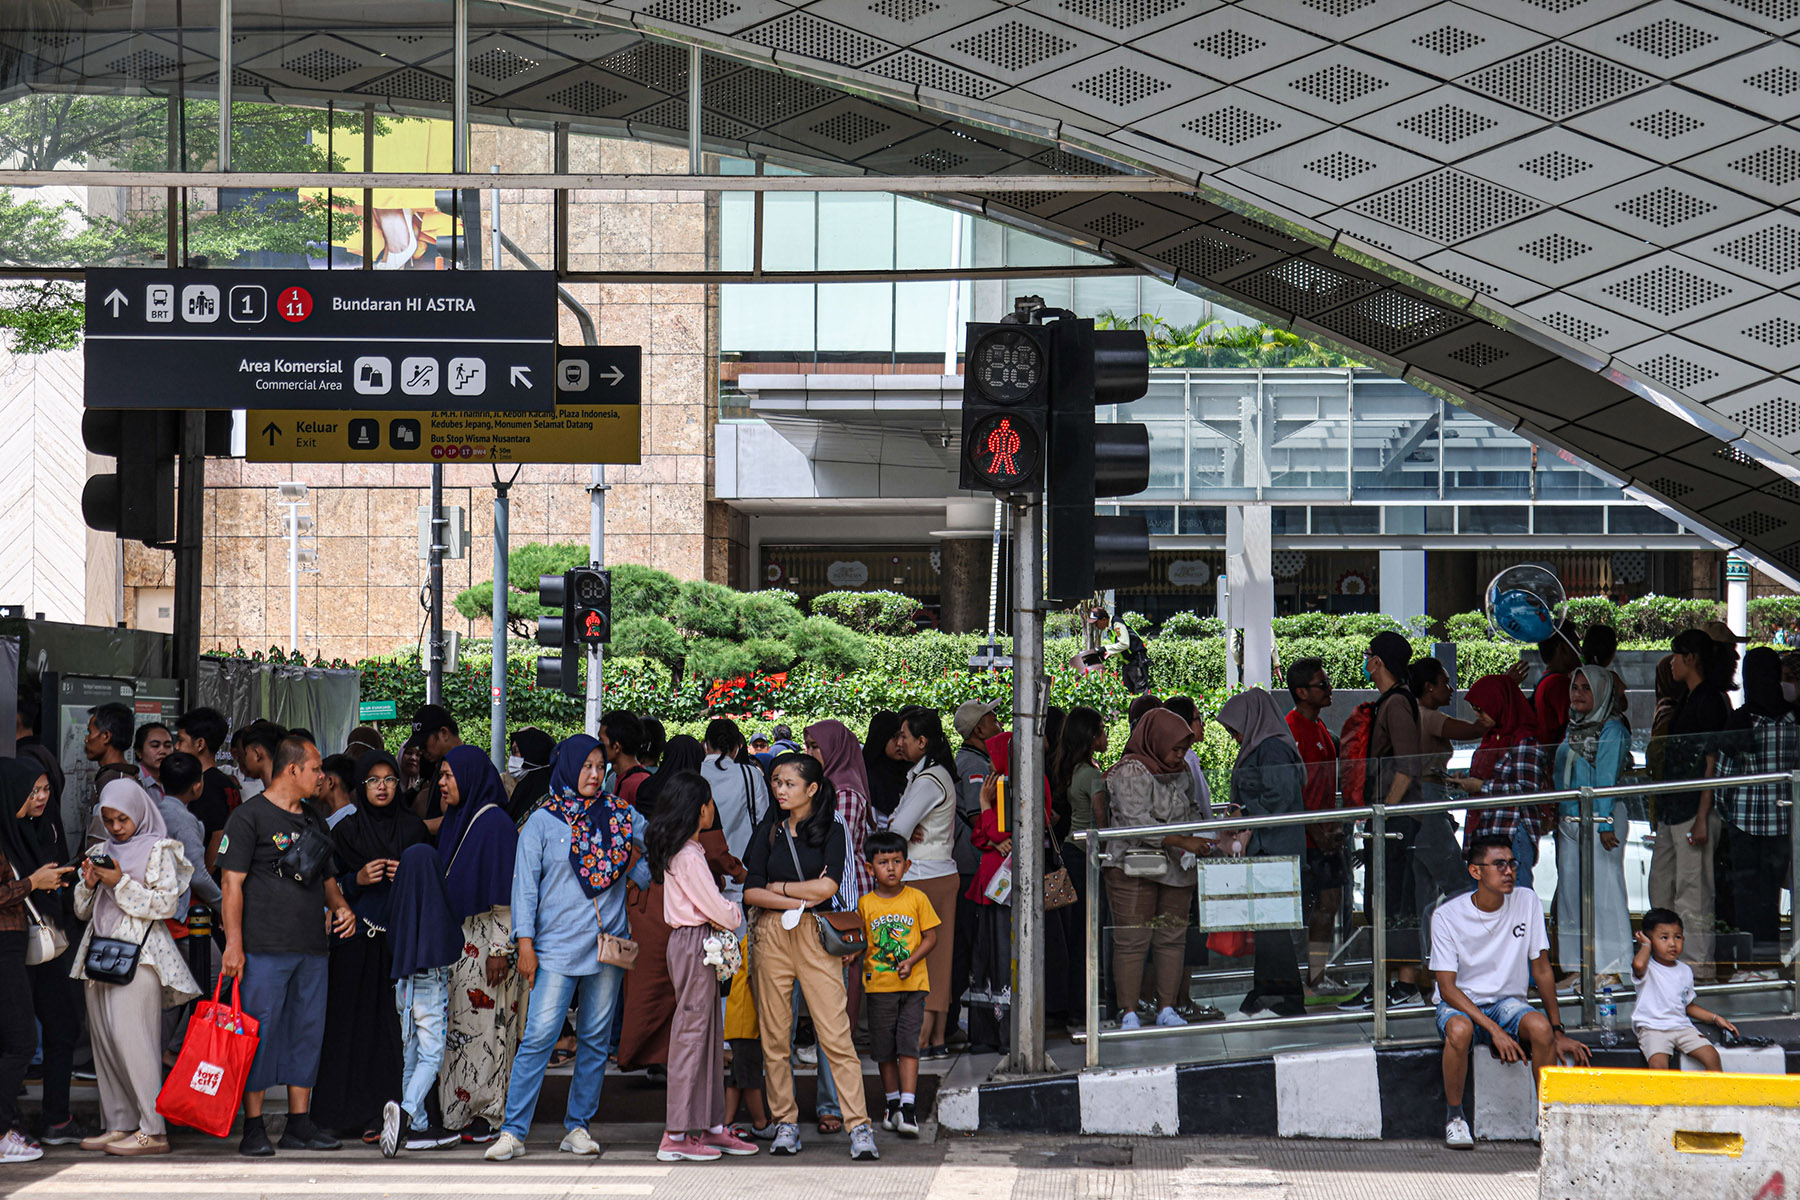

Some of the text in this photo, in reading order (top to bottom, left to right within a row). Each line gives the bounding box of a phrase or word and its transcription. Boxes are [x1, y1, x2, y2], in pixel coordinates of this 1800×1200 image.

[291, 290, 299, 300] 1
[241, 295, 254, 314] 1
[286, 302, 305, 316] 11
[332, 297, 476, 311] Bundaran HI ASTRA
[151, 310, 169, 319] BRT
[238, 359, 343, 373] Area Komersial
[255, 379, 342, 391] Commercial Area
[559, 409, 580, 418] Plaza
[581, 409, 620, 419] Indonesia,
[296, 421, 338, 433] Keluar
[431, 419, 593, 431] Kedubes Jepang, Monumen Selamat Datang
[296, 437, 317, 448] Exit
[431, 434, 531, 444] Bus Stop Wisma Nusantara
